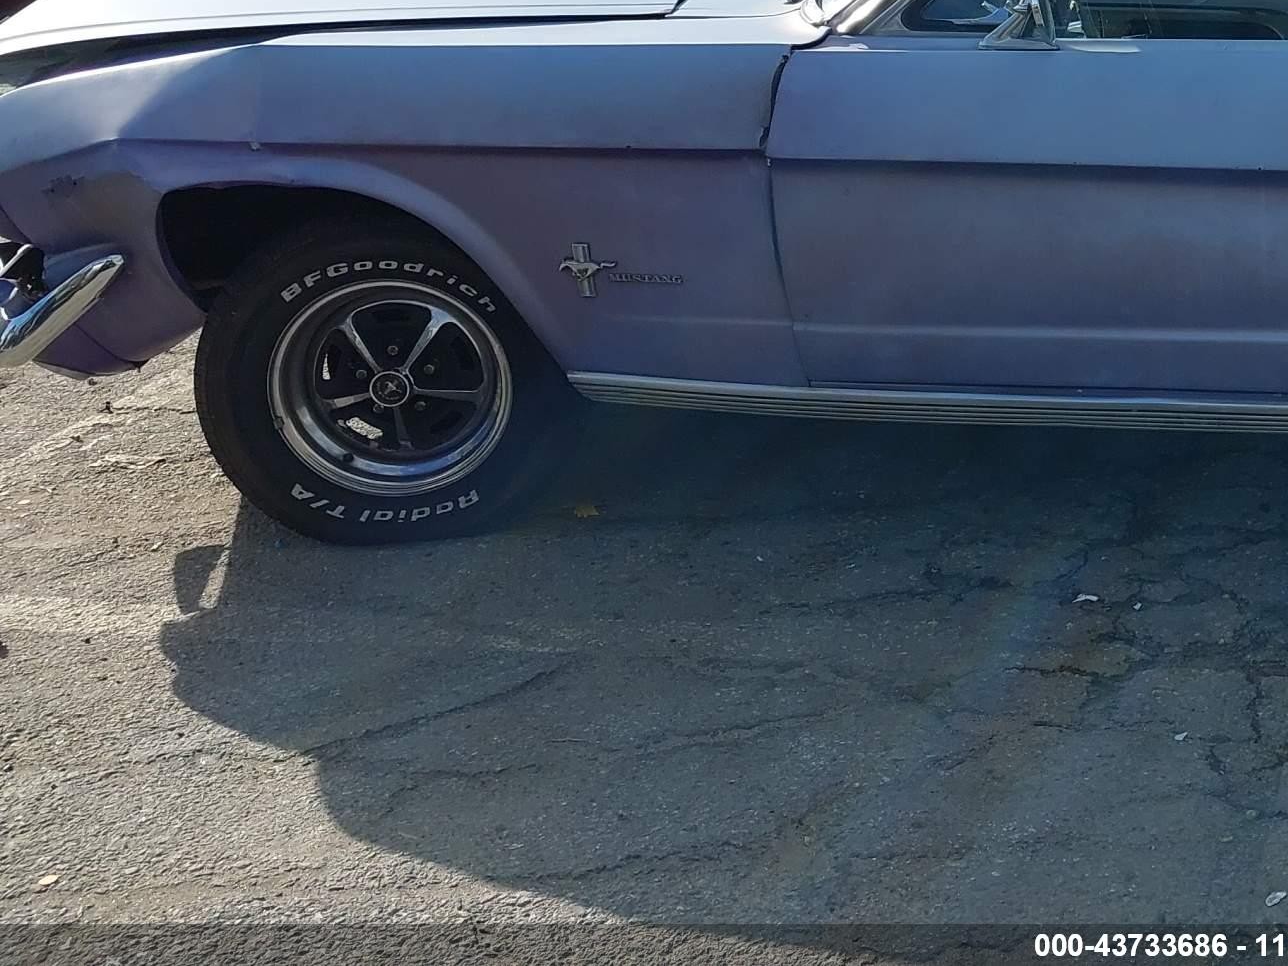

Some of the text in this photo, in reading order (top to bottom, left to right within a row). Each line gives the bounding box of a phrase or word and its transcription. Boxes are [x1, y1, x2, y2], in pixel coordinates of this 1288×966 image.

[280, 260, 497, 313] BFGoodrich
[608, 273, 683, 284] MUSTANG
[290, 483, 480, 523] Radial T/A
